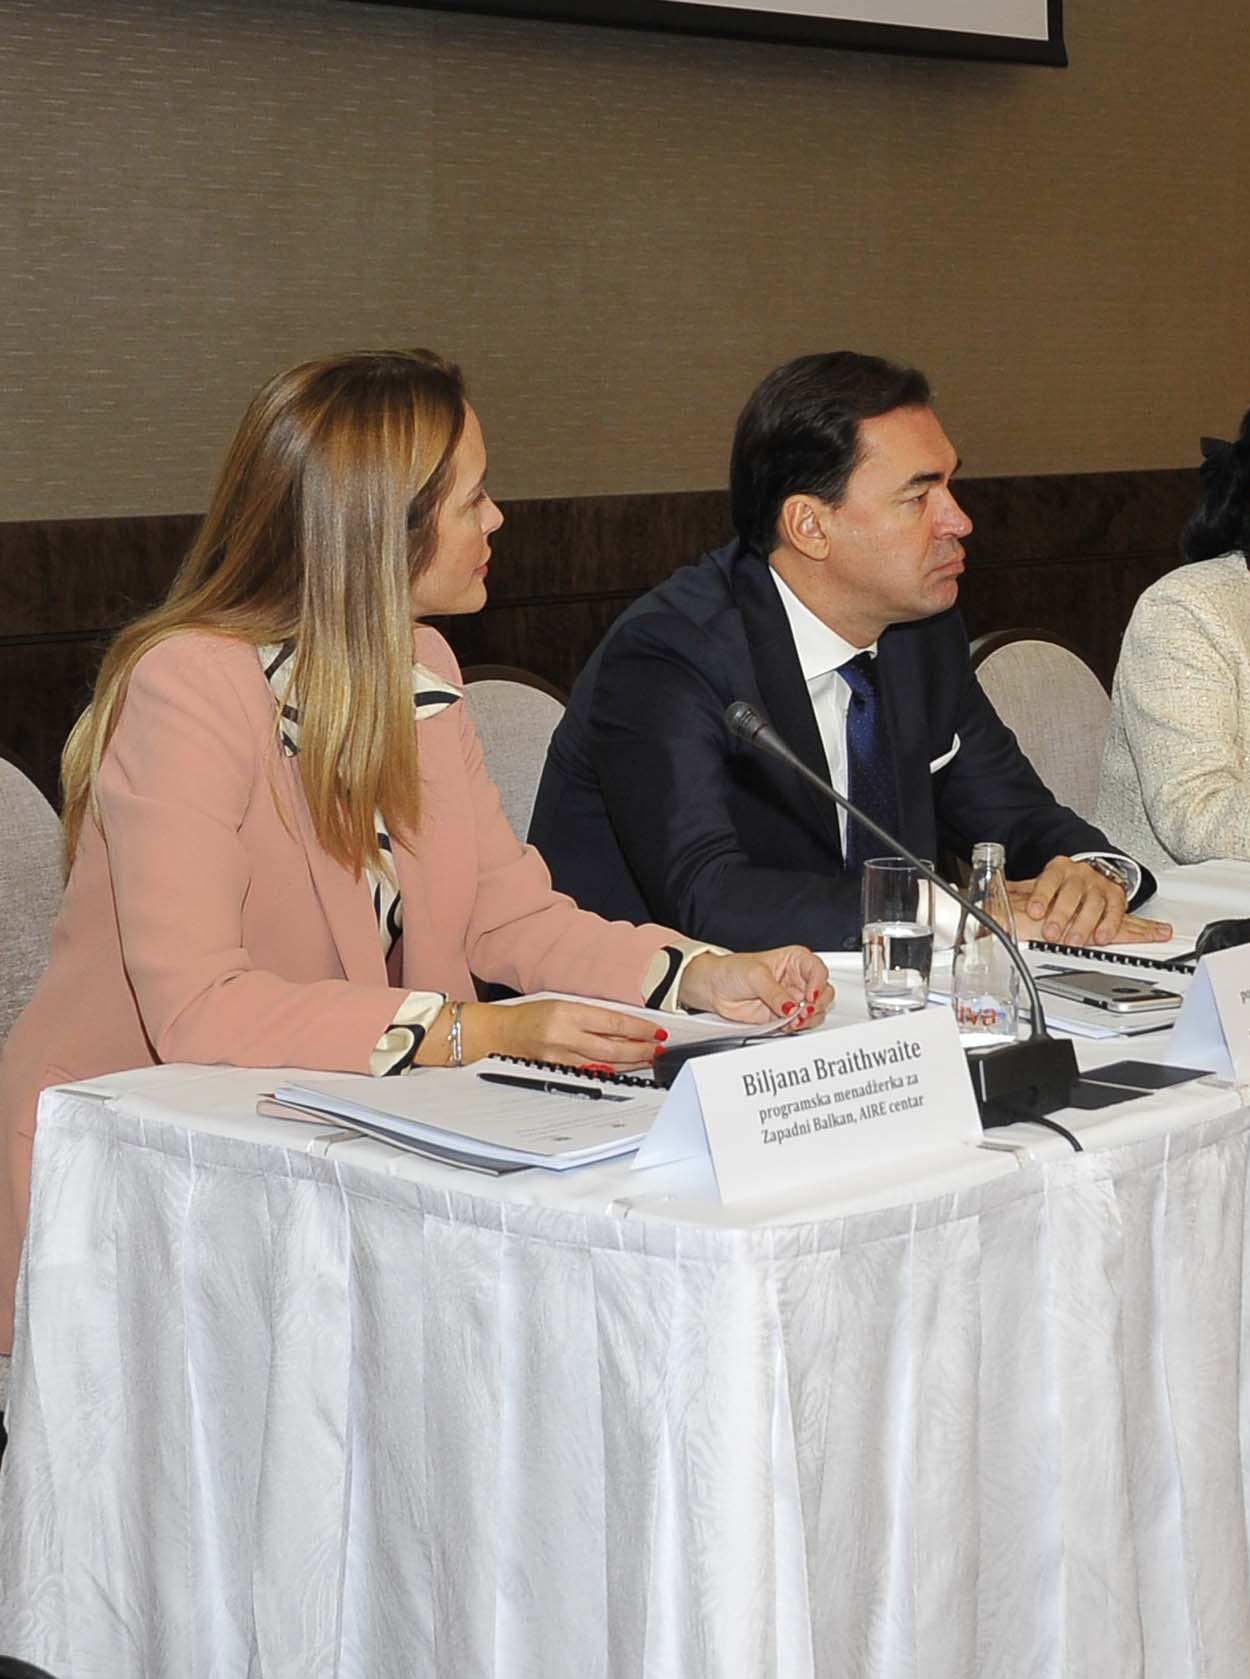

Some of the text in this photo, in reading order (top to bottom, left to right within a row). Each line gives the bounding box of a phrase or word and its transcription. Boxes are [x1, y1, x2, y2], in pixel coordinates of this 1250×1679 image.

[741, 1039, 923, 1097] Biljana Braithwaite
[759, 1073, 920, 1125] programska menadžerka za
[761, 1095, 925, 1145] Zapadni Balkan, AIRE centar
